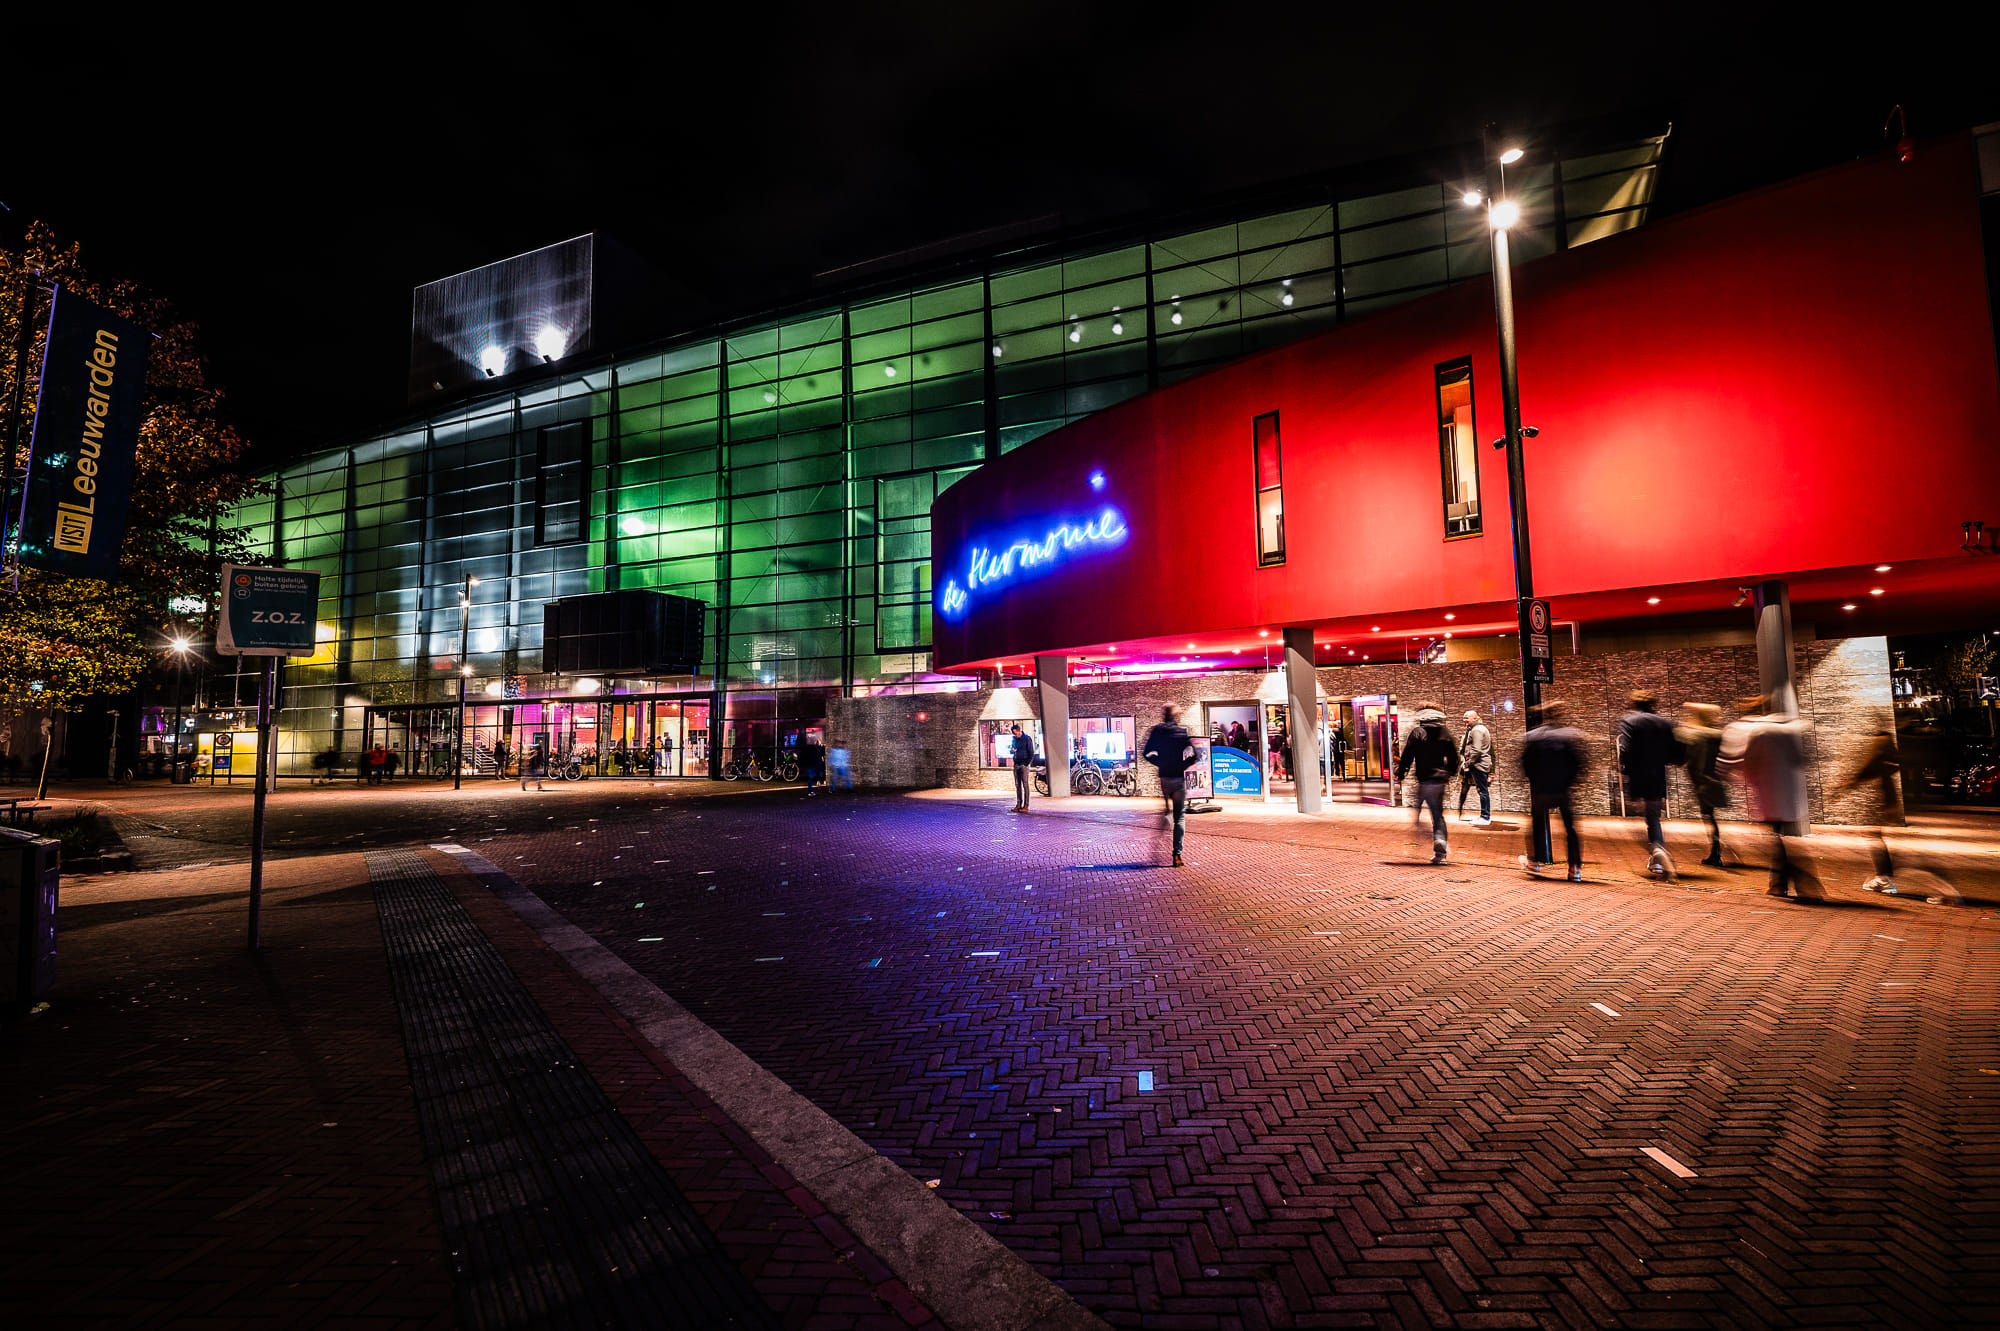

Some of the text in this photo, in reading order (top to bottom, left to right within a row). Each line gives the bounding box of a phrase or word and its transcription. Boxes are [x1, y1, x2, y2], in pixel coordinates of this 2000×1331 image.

[58, 328, 119, 547] VISIT Leeuwarden
[278, 576, 305, 584] tijdelijk
[943, 580, 967, 612] de
